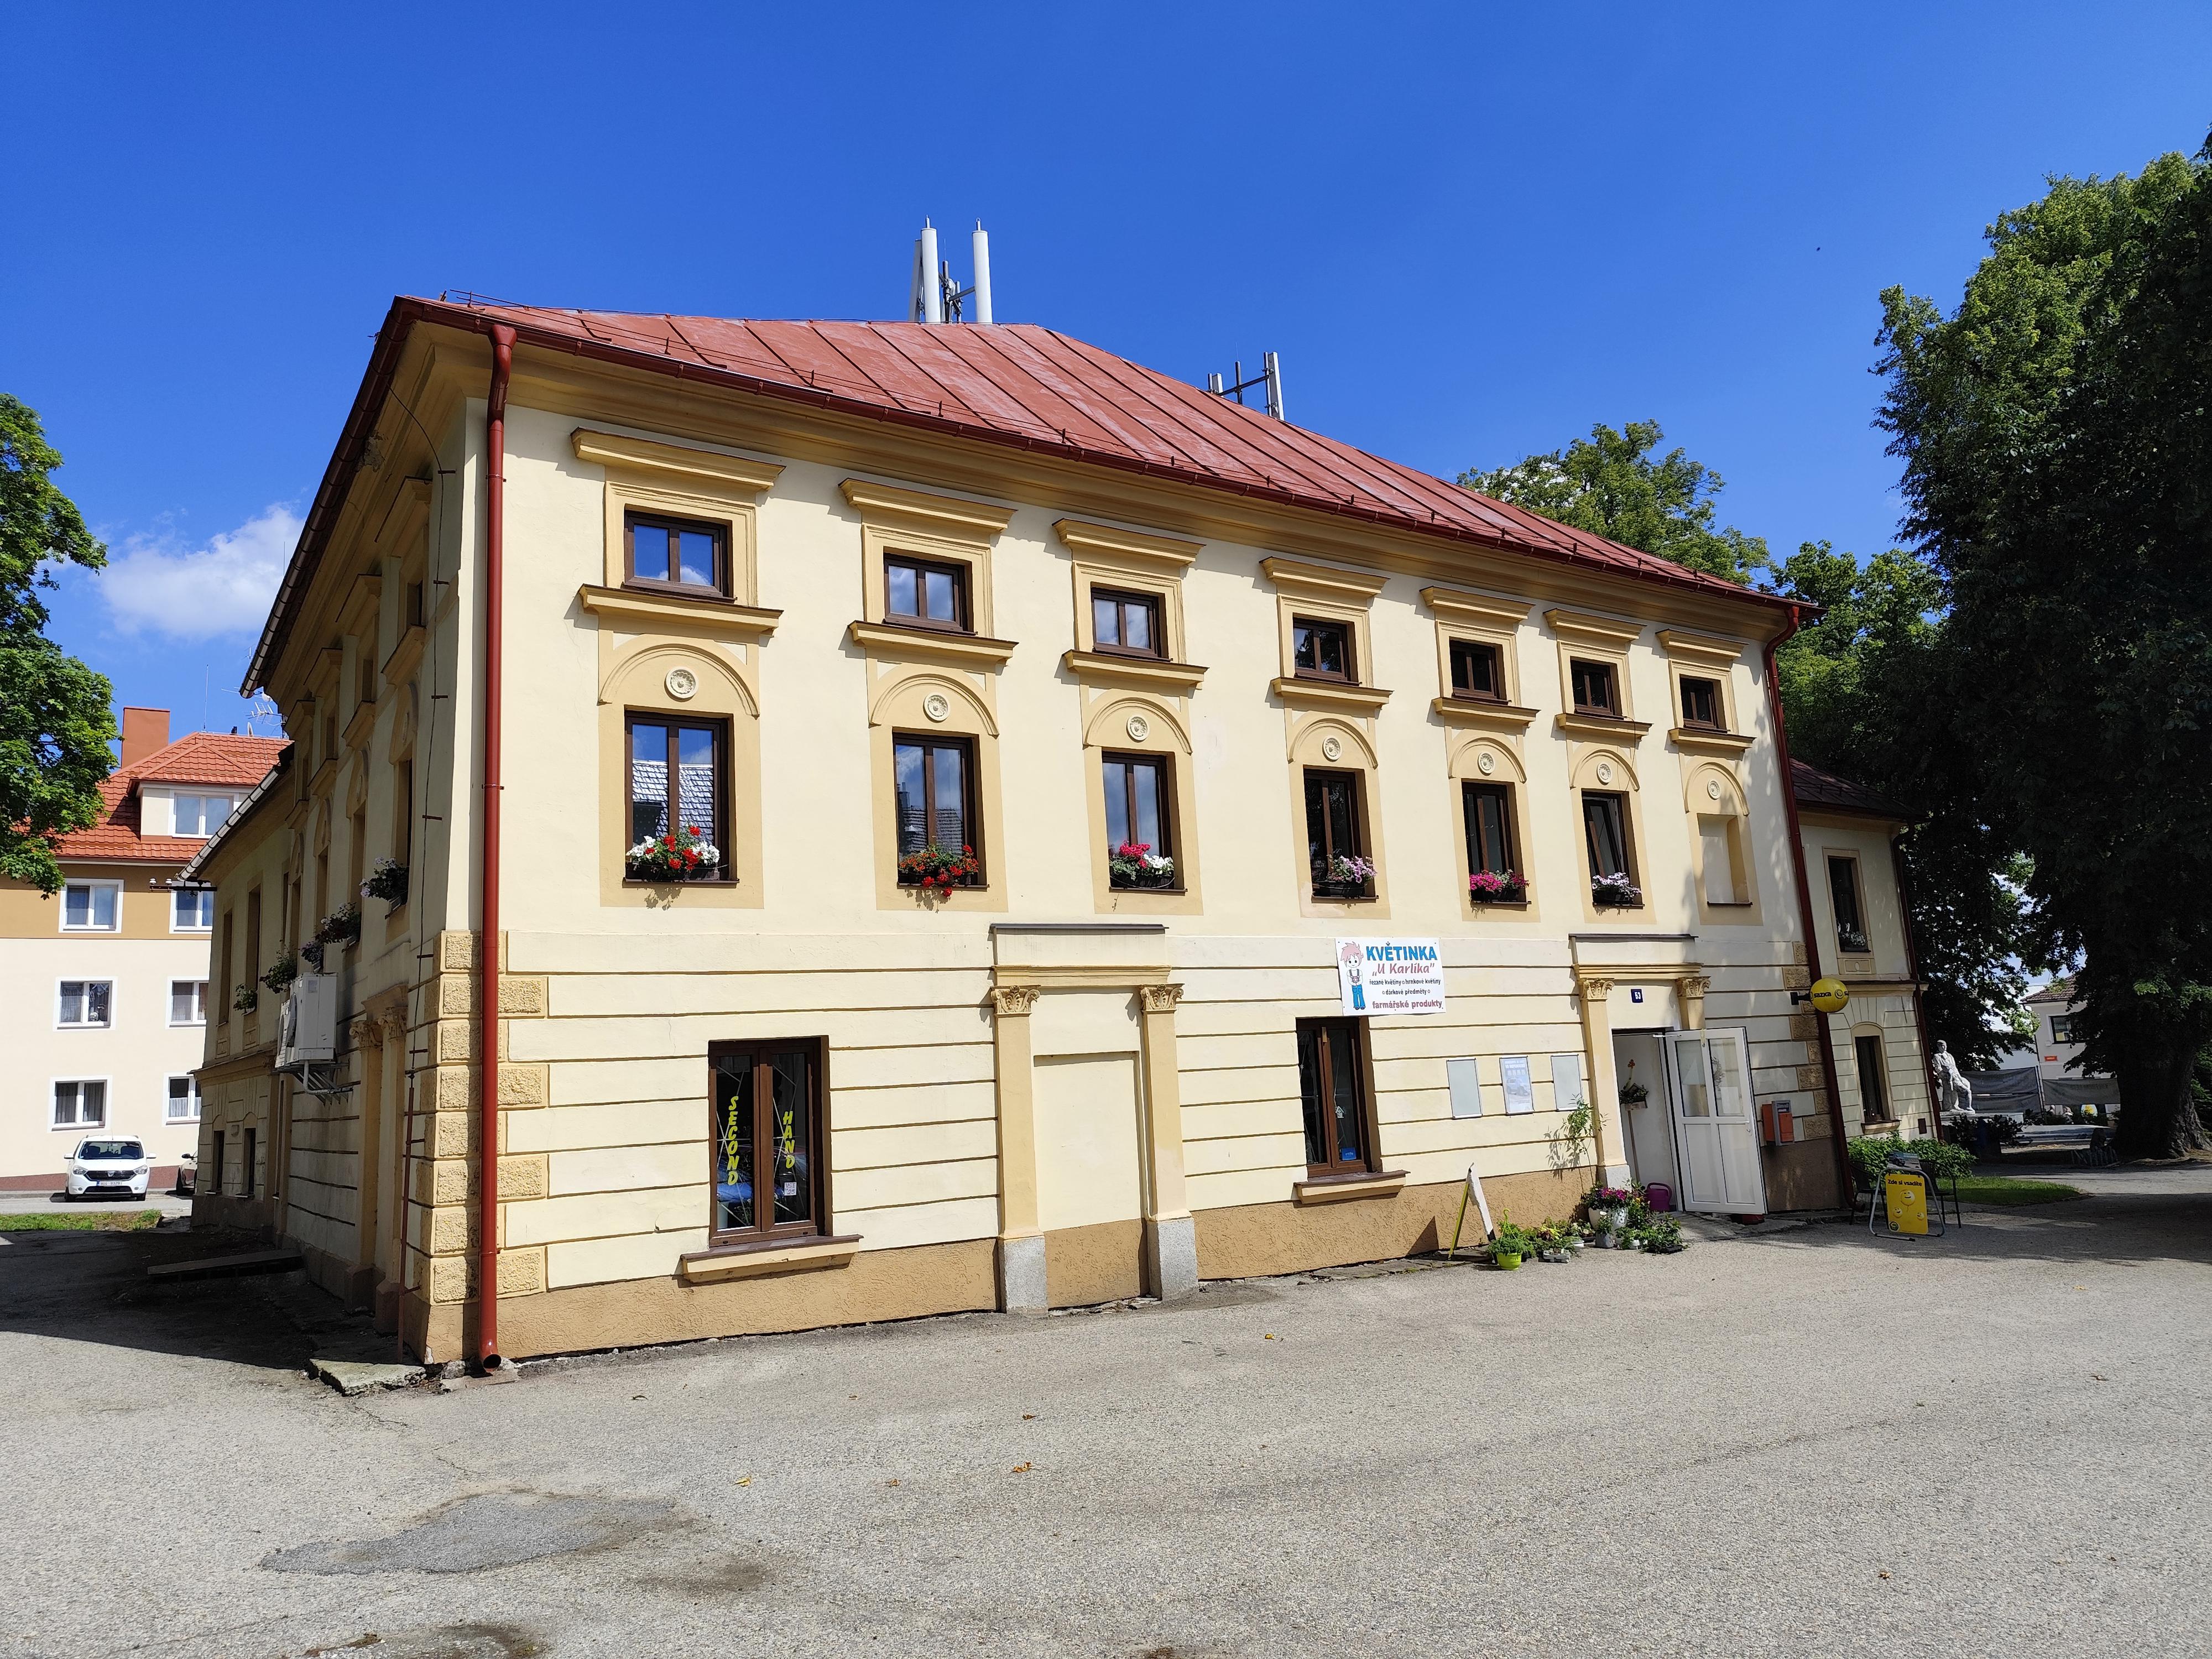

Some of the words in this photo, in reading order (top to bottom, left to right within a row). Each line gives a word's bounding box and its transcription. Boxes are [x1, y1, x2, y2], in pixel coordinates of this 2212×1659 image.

[1366, 941, 1438, 961] KVĚTINKA
[1373, 1000, 1409, 1009] farmářské
[1411, 1000, 1442, 1009] produkty
[727, 1095, 740, 1186] SECOND
[783, 1110, 795, 1168] HAND
